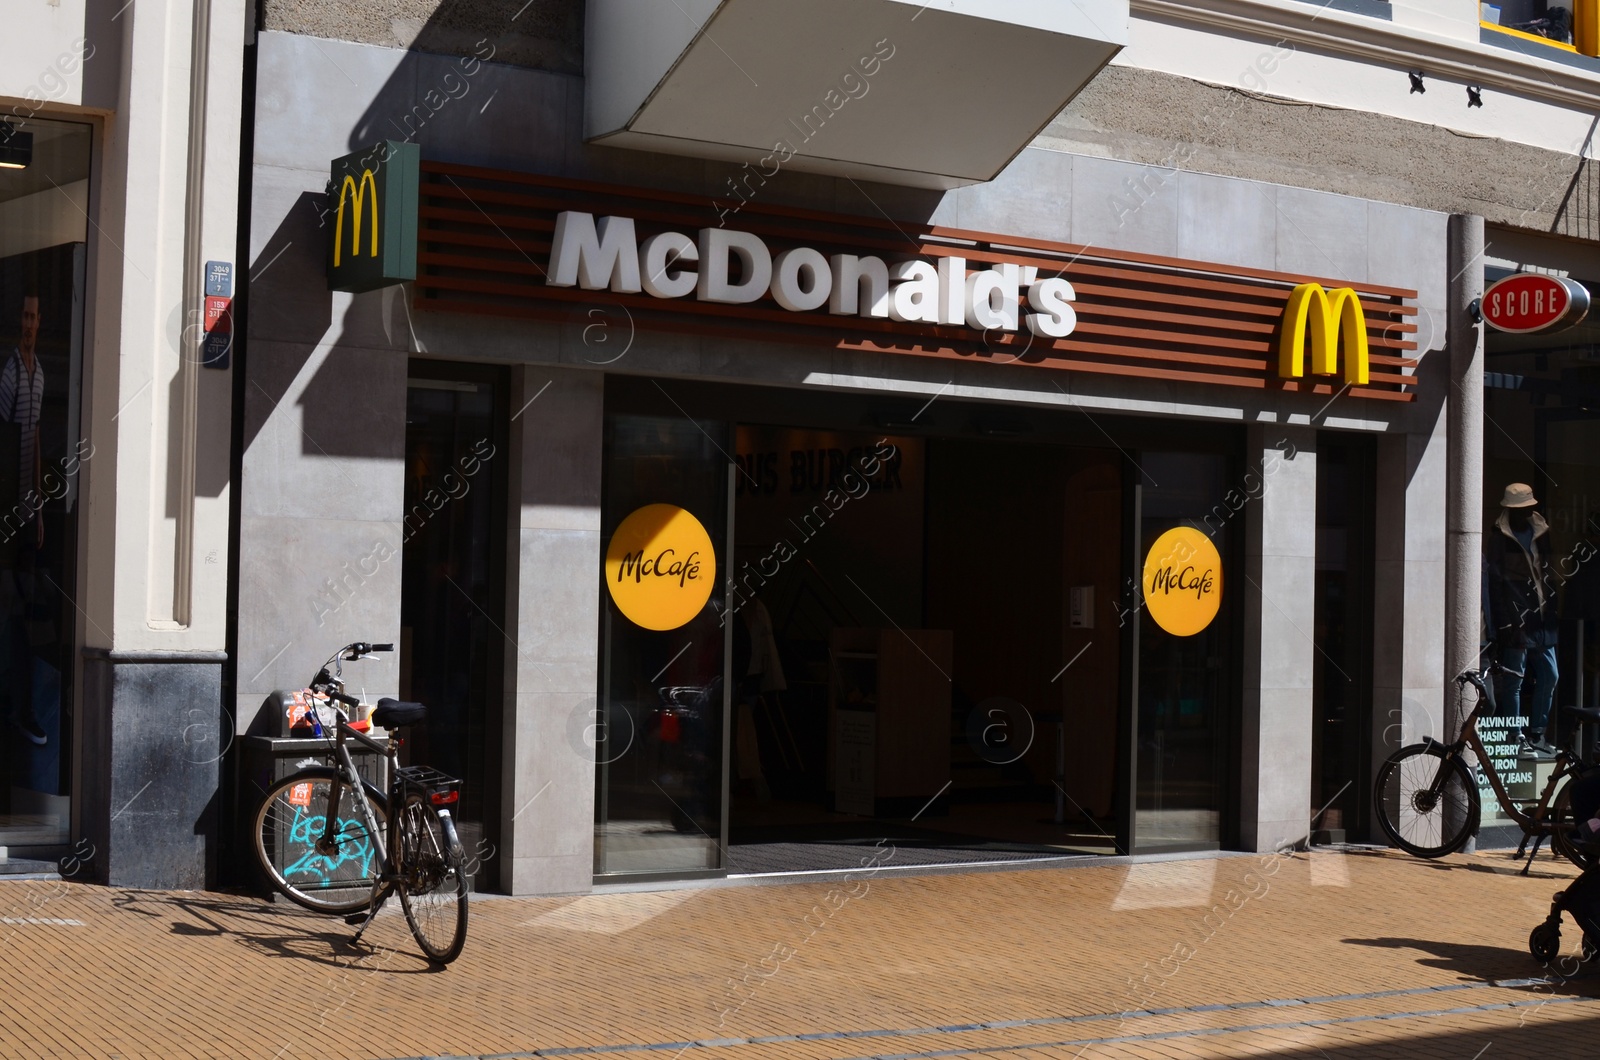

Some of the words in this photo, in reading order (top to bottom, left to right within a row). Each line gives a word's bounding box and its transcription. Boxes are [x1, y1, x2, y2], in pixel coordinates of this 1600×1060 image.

[545, 210, 1076, 338] McDonald's
[1491, 288, 1557, 319] SCORE
[736, 451, 778, 497] OUS
[617, 549, 700, 588] McCafé
[1151, 566, 1213, 600] McCafé
[1505, 716, 1530, 727] KLEIN
[1479, 730, 1508, 742] HASIN'
[1495, 744, 1521, 756] PERRY
[1495, 758, 1517, 770] IRON
[1506, 772, 1533, 784] JEANS
